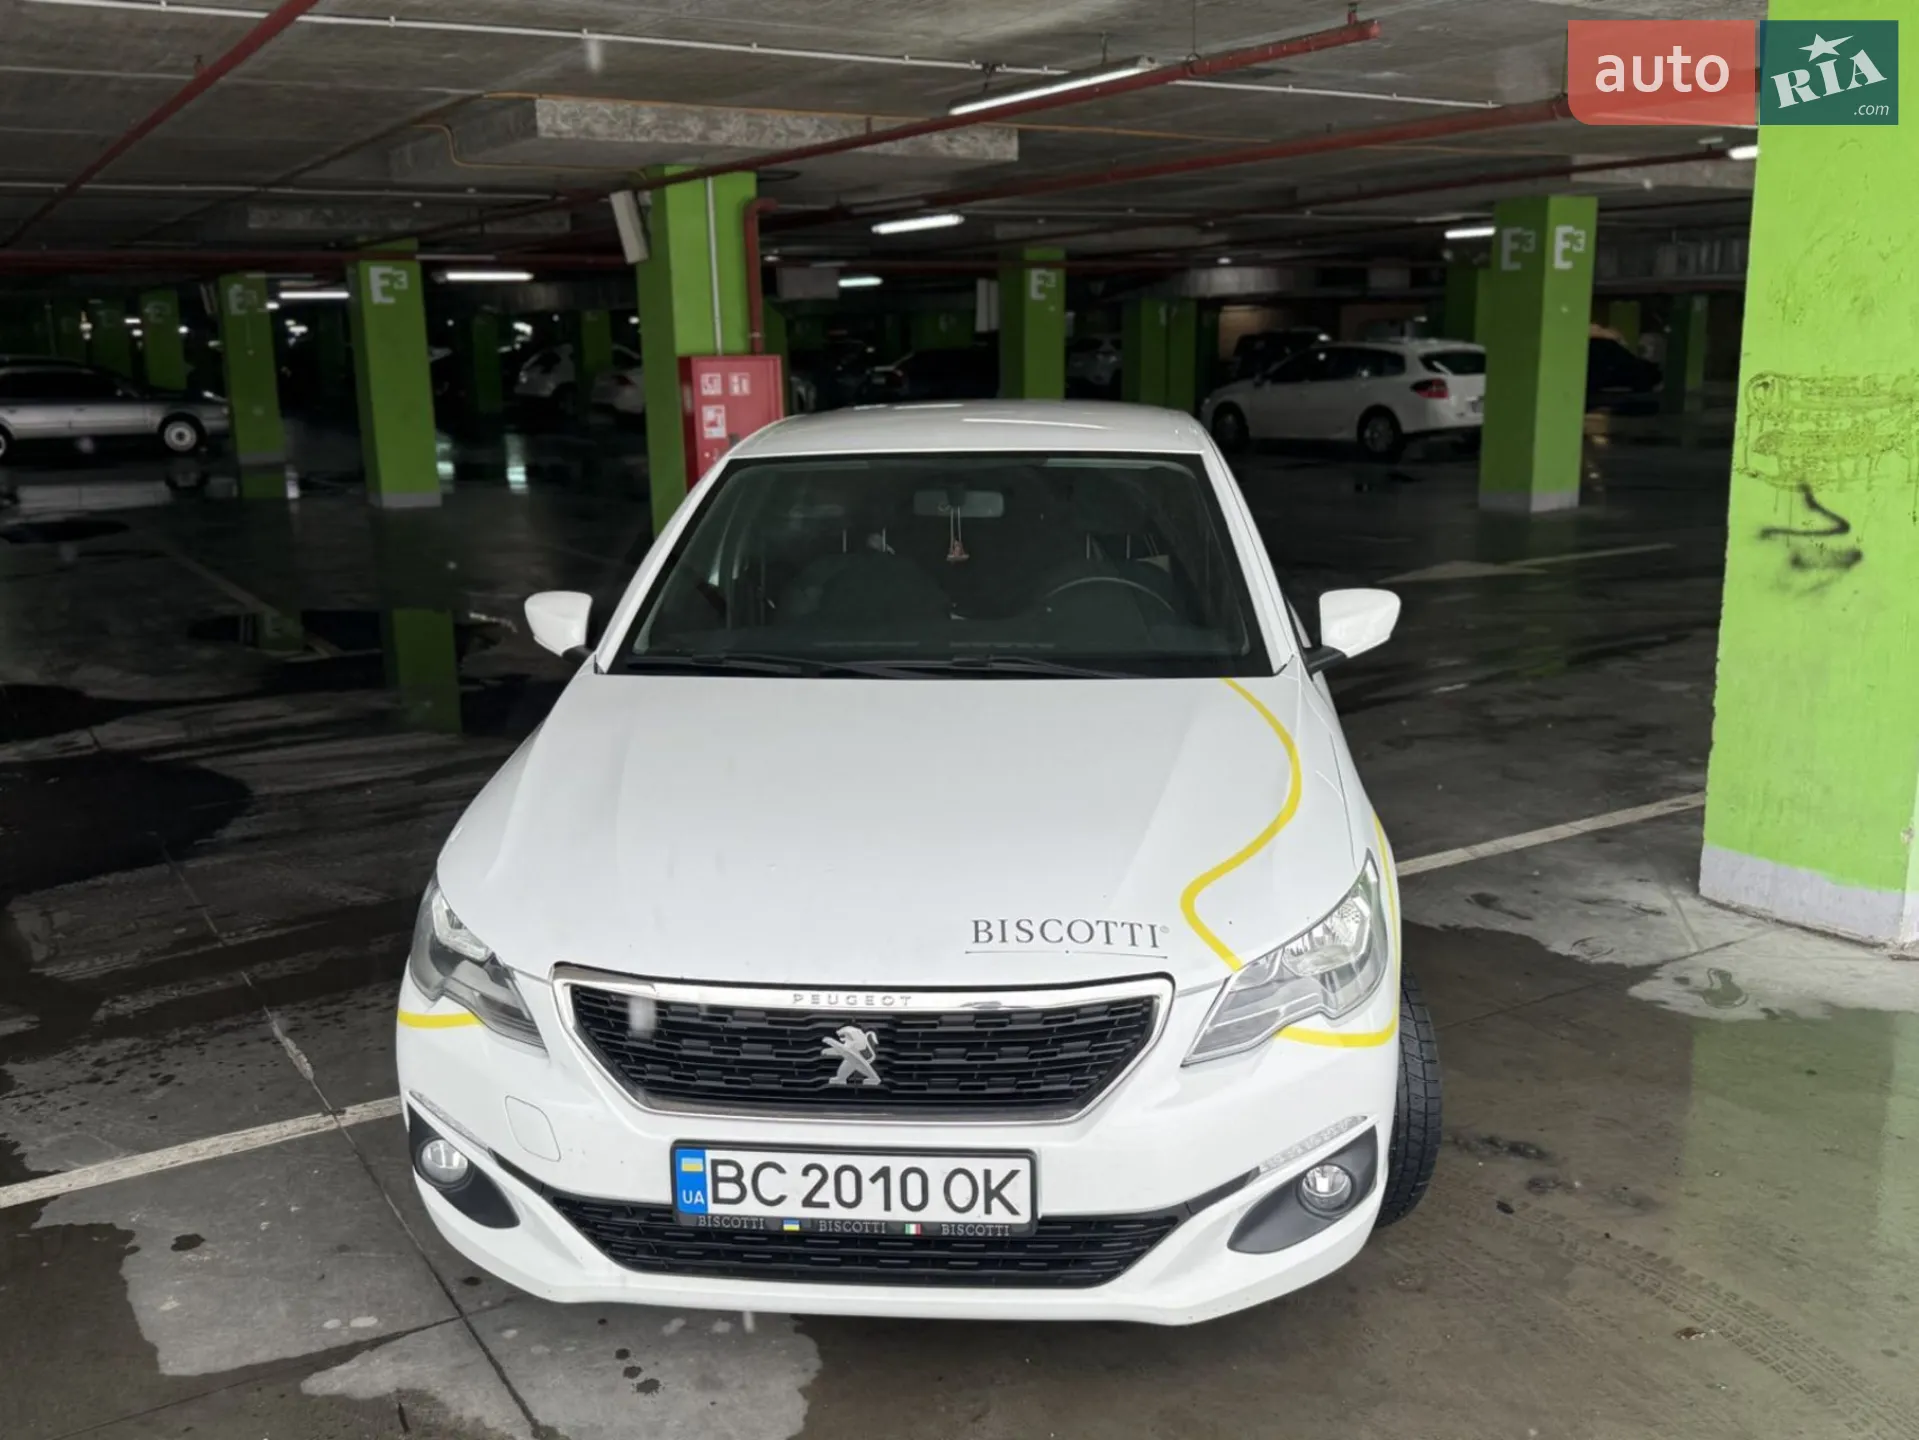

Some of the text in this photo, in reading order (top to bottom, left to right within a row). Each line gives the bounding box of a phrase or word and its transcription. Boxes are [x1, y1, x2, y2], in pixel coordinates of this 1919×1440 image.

[971, 918, 1161, 949] BISCOTTI
[792, 993, 912, 1007] PEUGEOT
[682, 1189, 705, 1205] UA
[709, 1158, 1022, 1217] BC 2010 OK
[697, 1216, 1011, 1237] BISCOTTI BISCOTTI BISCOTTI
